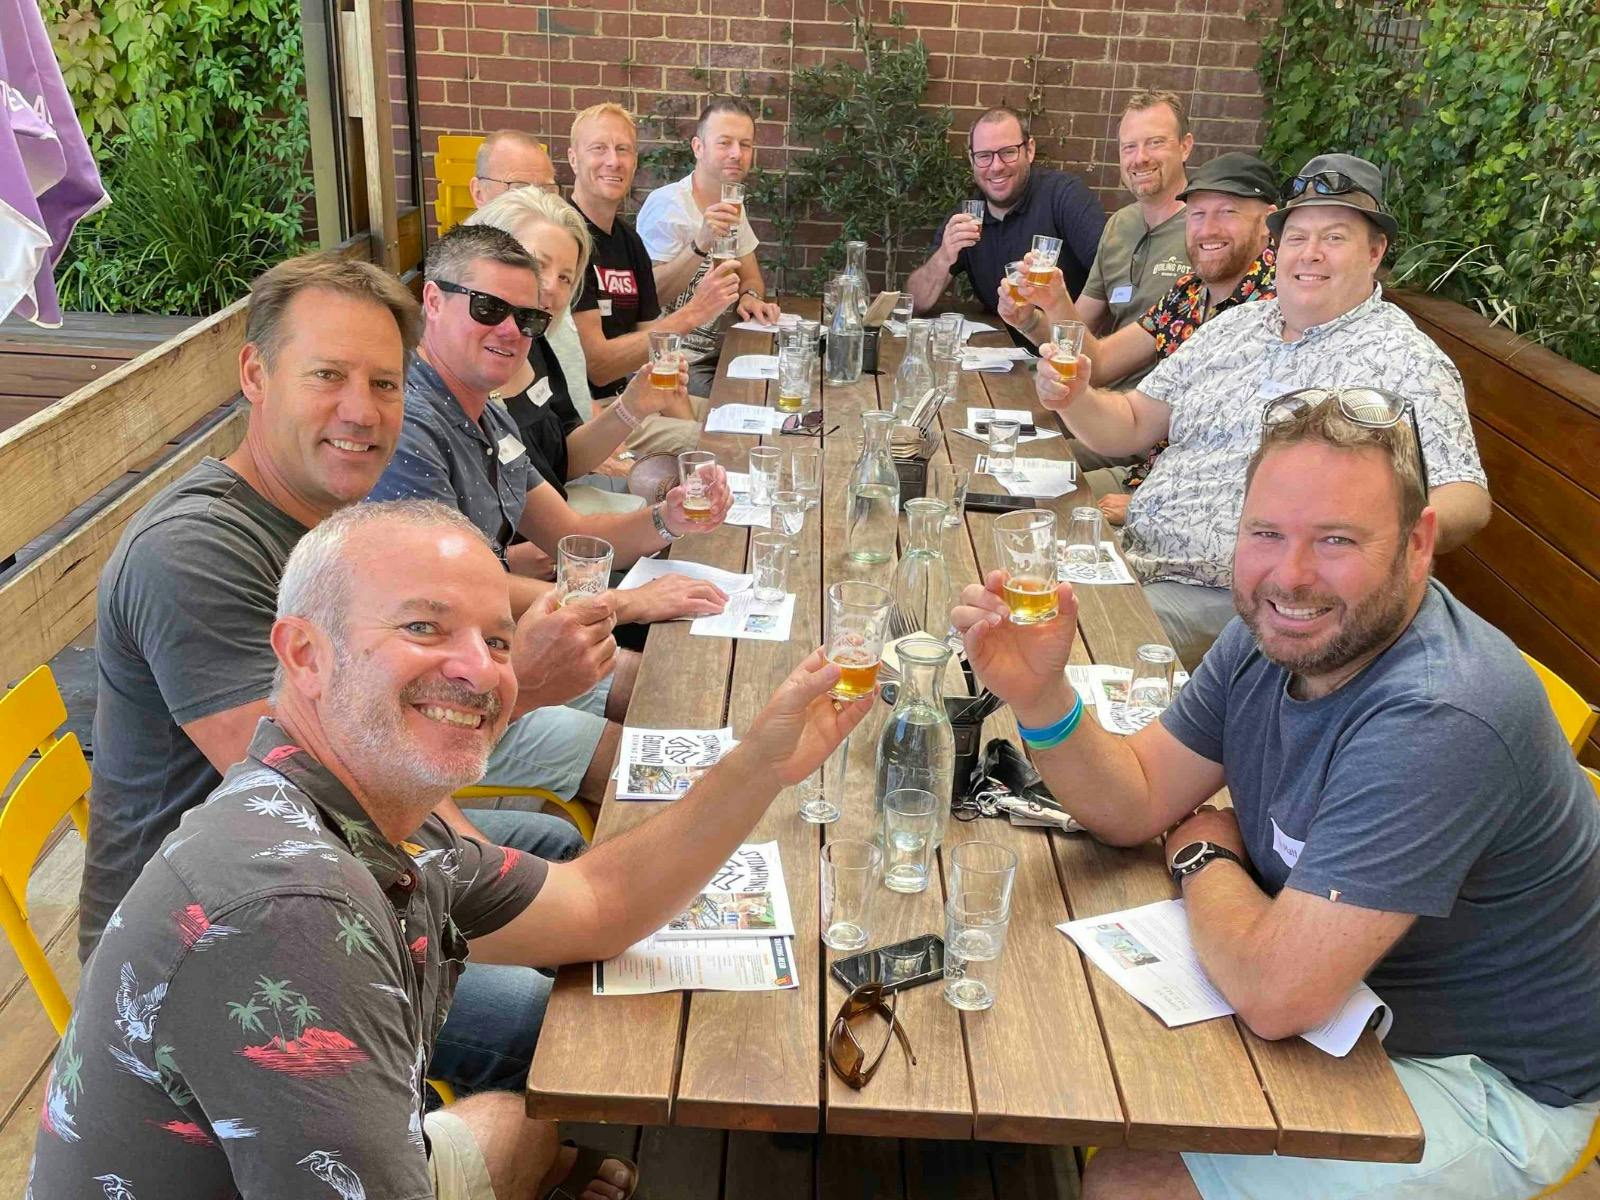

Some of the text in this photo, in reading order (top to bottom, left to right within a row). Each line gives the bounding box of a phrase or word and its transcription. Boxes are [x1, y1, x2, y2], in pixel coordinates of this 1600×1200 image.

[593, 264, 632, 293] VANS
[641, 734, 665, 764] GROUND
[738, 850, 769, 892] STOMPING
